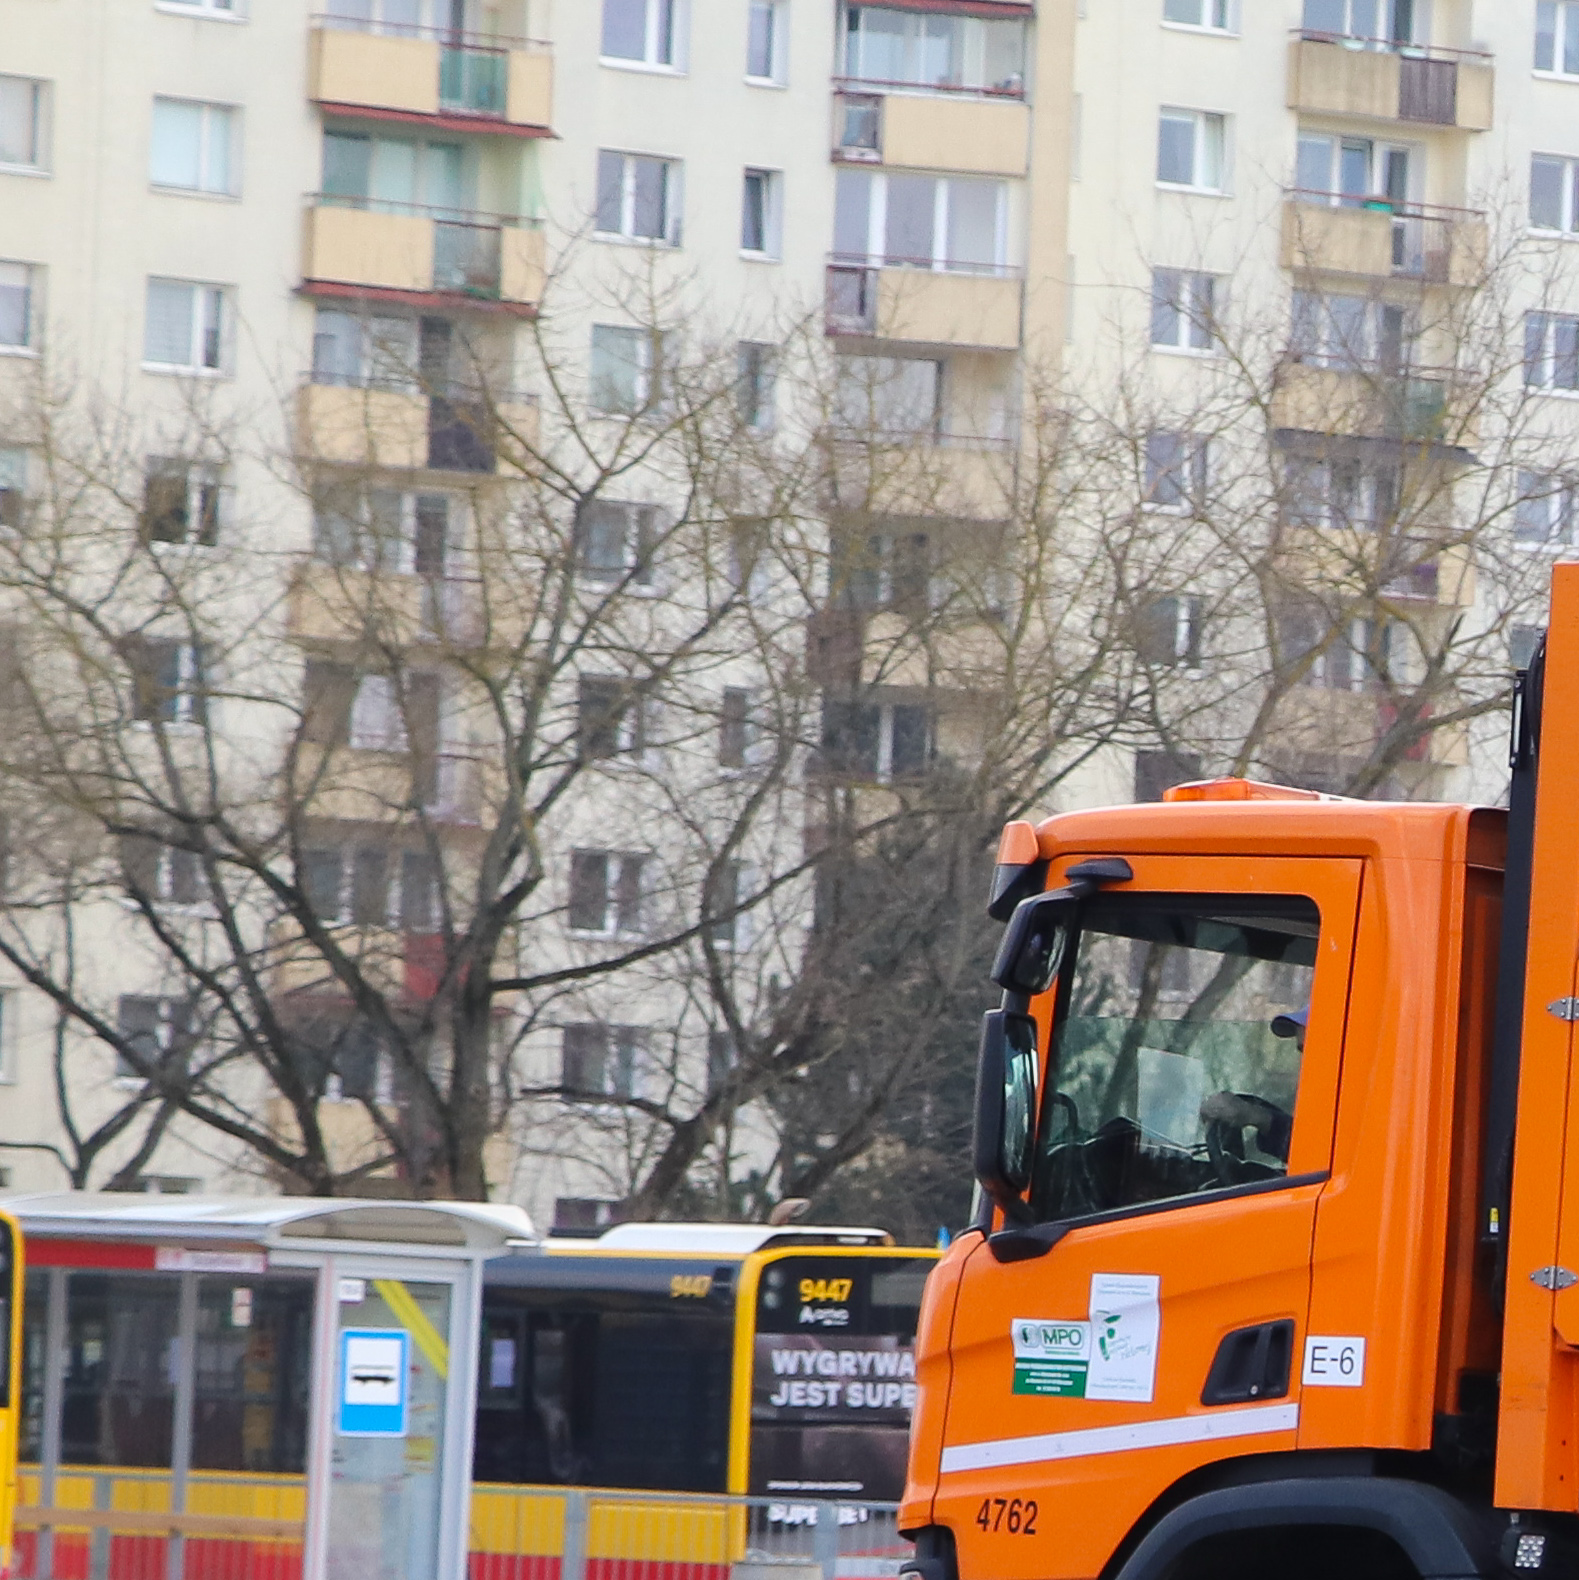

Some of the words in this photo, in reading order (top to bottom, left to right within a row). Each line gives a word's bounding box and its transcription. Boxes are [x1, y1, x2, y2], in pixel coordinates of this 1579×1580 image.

[800, 1279, 853, 1302] 9447
[1042, 1329, 1082, 1346] MPO
[1310, 1346, 1355, 1375] E-6
[769, 1380, 842, 1407] JEST
[975, 1498, 1039, 1536] 4762
